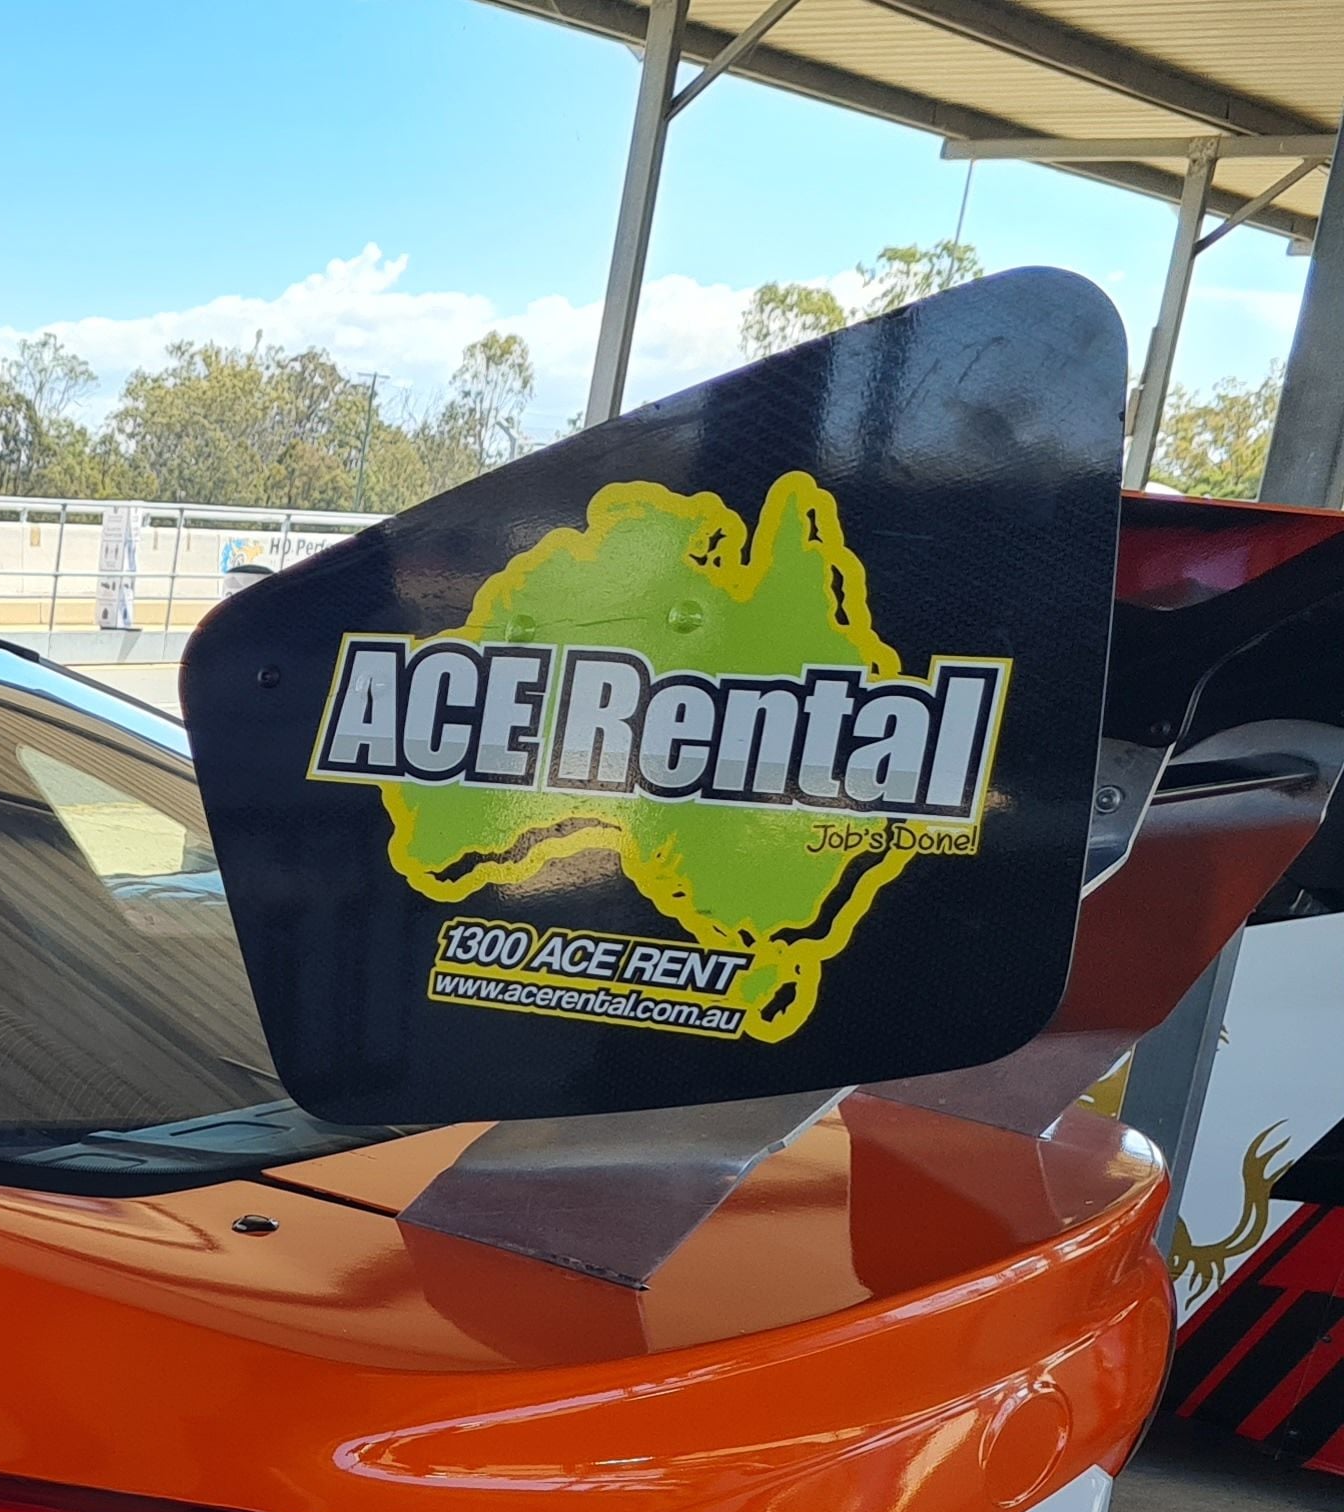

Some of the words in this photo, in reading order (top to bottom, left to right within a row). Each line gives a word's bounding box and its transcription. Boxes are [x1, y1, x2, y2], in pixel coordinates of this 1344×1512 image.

[324, 643, 548, 780] ACE
[556, 651, 988, 812] Rental
[806, 823, 887, 856] Job's
[892, 821, 980, 856] Done!
[442, 924, 528, 970] 1300
[531, 935, 626, 980] ACE
[622, 946, 750, 993] RENT
[432, 972, 743, 1031] www.acerental.com.au
